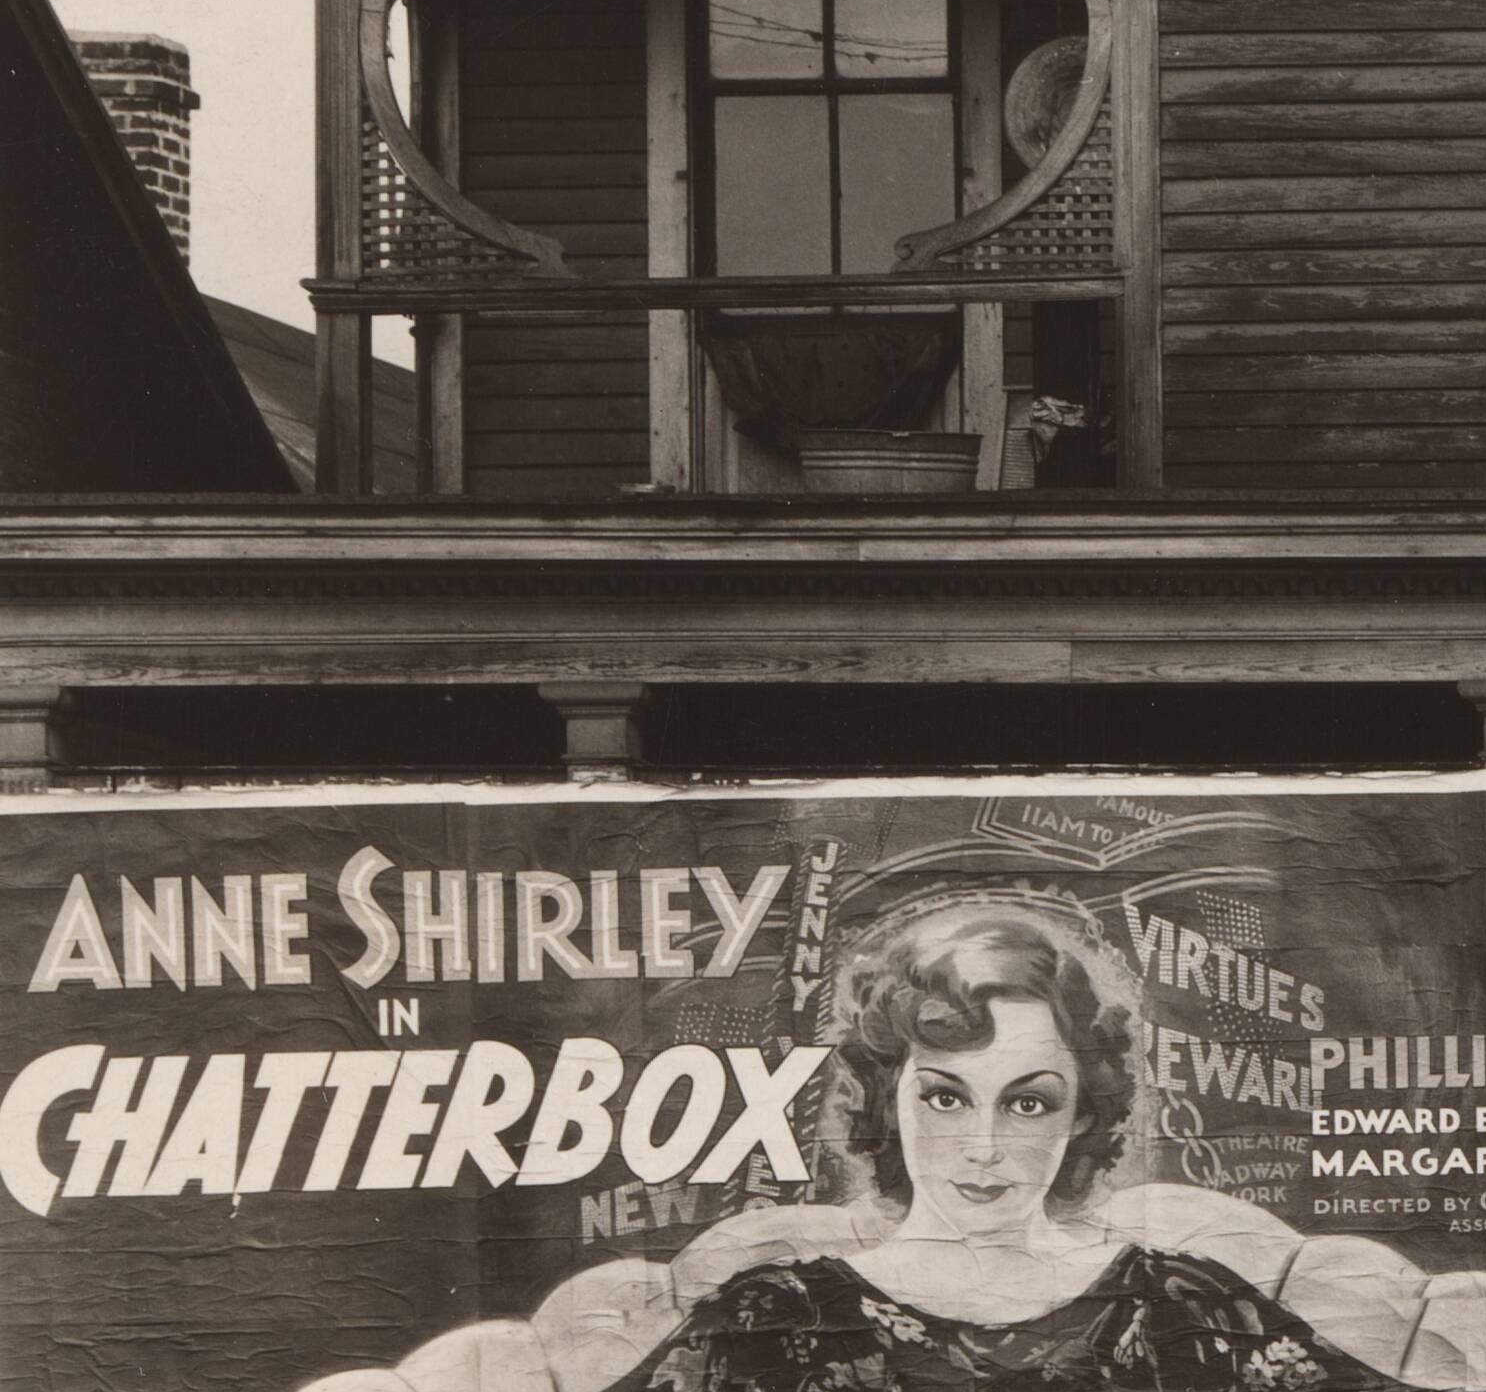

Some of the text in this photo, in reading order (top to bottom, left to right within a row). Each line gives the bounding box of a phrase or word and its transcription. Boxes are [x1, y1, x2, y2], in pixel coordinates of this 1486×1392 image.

[27, 845, 791, 993] ANNE SHIRLEY
[790, 842, 838, 1011] JENNY
[1123, 903, 1324, 1031] VIRTUES
[378, 997, 420, 1036] IN
[0, 1038, 838, 1217] CHATTERBOX
[1313, 1108, 1460, 1136] EDWARD
[580, 1180, 699, 1245] NEW
[1314, 1197, 1431, 1215] DIRECTED
[1444, 1196, 1471, 1213] BY
